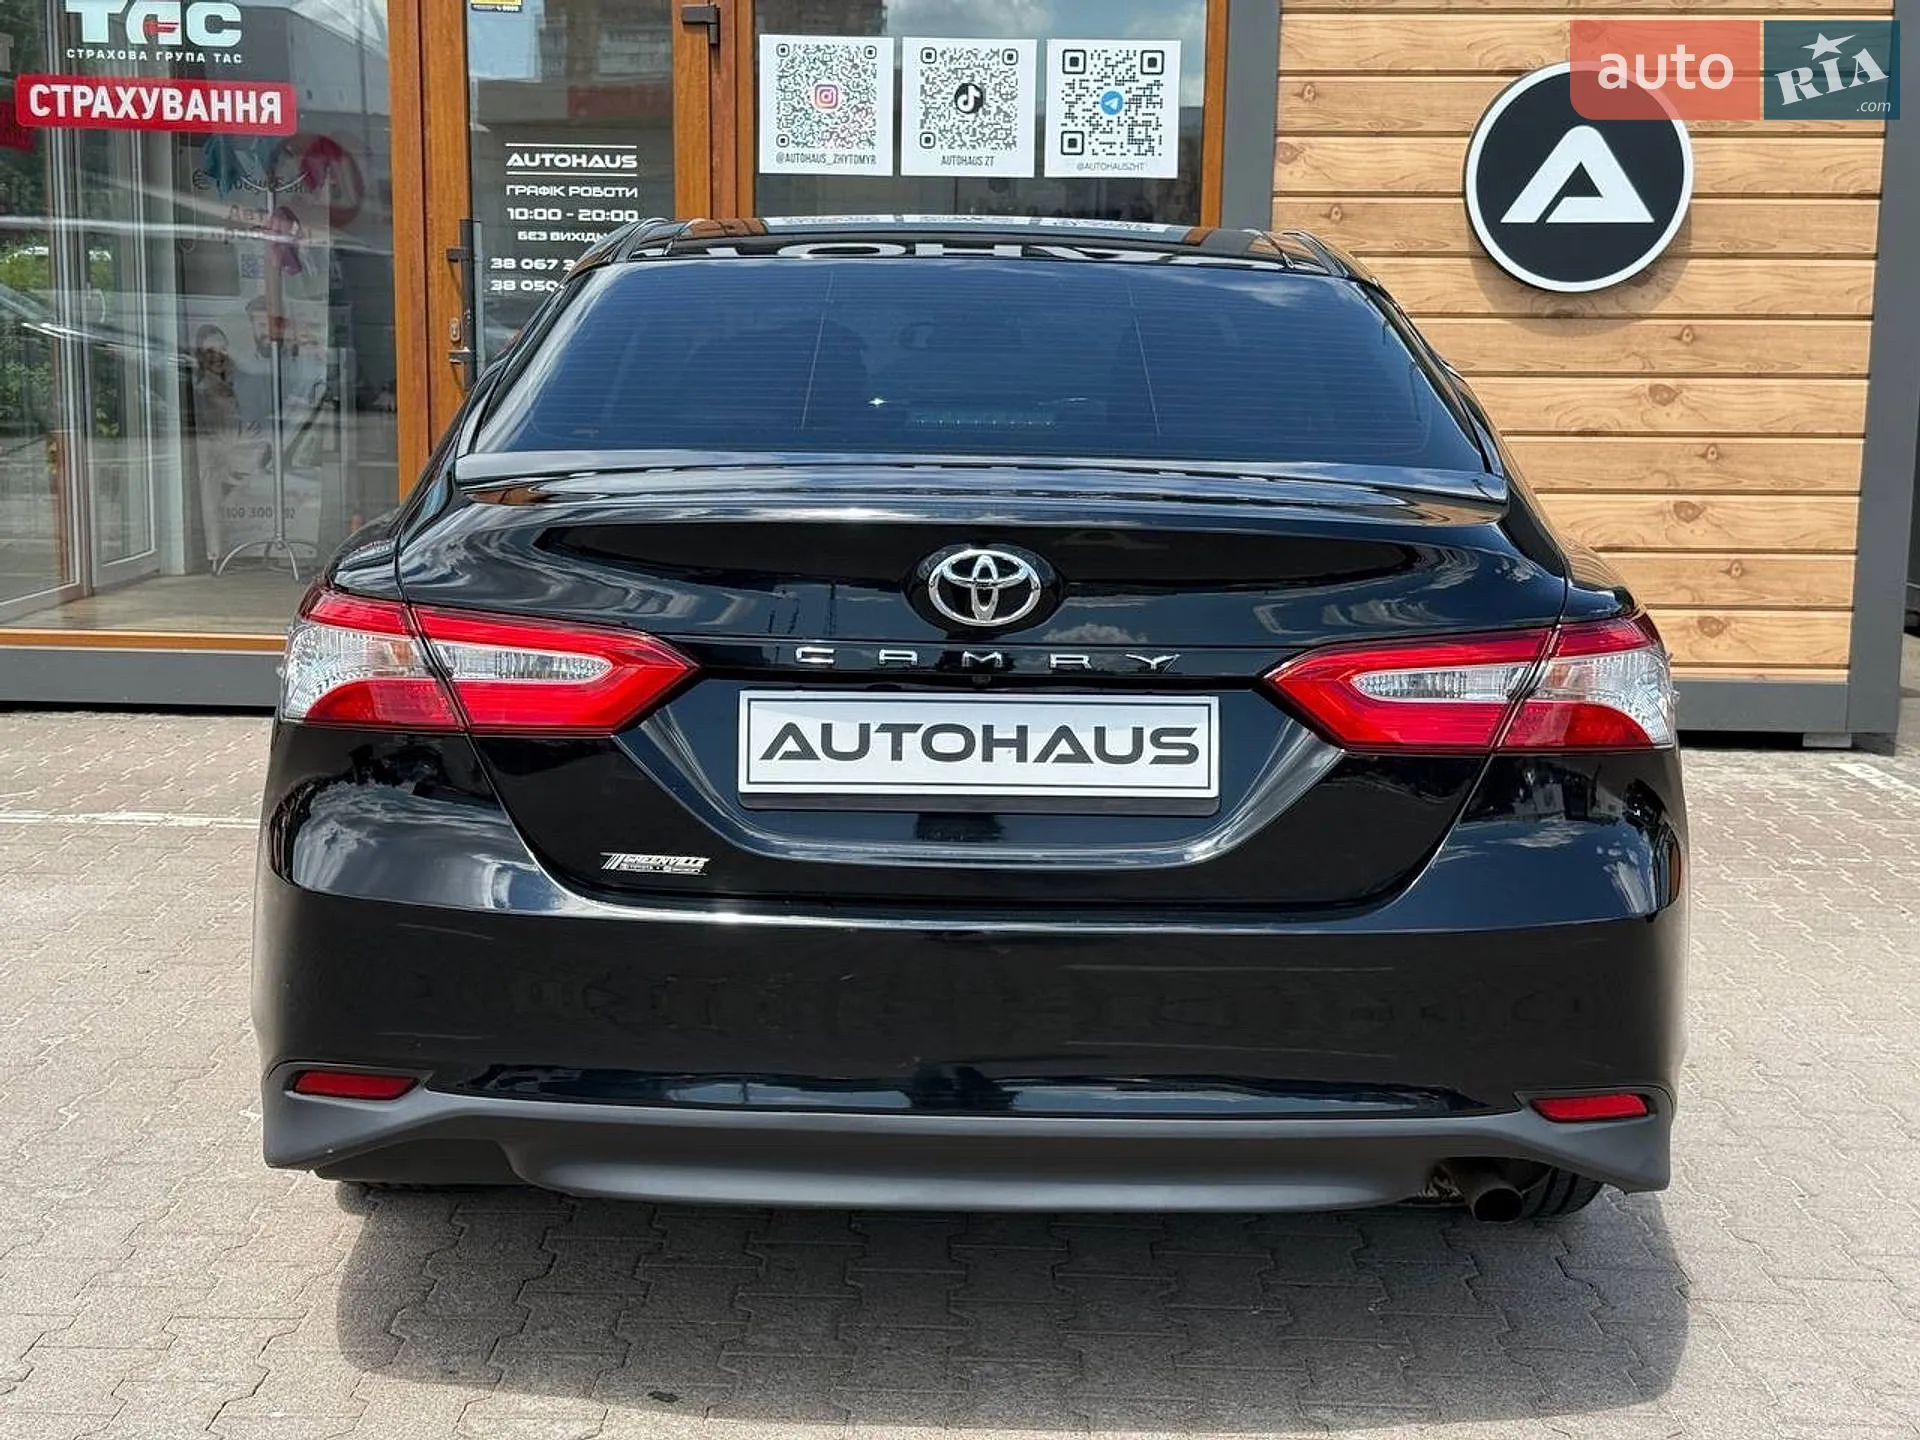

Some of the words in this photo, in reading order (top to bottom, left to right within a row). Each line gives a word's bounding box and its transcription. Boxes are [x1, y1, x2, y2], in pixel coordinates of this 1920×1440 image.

[67, 48, 148, 61] СТРАХОВА
[155, 50, 206, 63] ГРУПА
[214, 52, 243, 64] ТАС
[29, 84, 282, 125] СТРАХУВАННЯ
[506, 153, 637, 168] AUTOHAUS
[506, 185, 566, 197] ГРАФІК
[568, 187, 638, 198] РОБОТИ
[507, 208, 562, 221] 10:00
[578, 209, 638, 222] 20:00
[517, 231, 547, 241] БЕЗ
[490, 258, 516, 270] 38
[520, 259, 559, 270] 067
[490, 280, 516, 291] 38
[795, 646, 1180, 671] CAMRY
[759, 721, 1200, 765] AUTOHAUS
